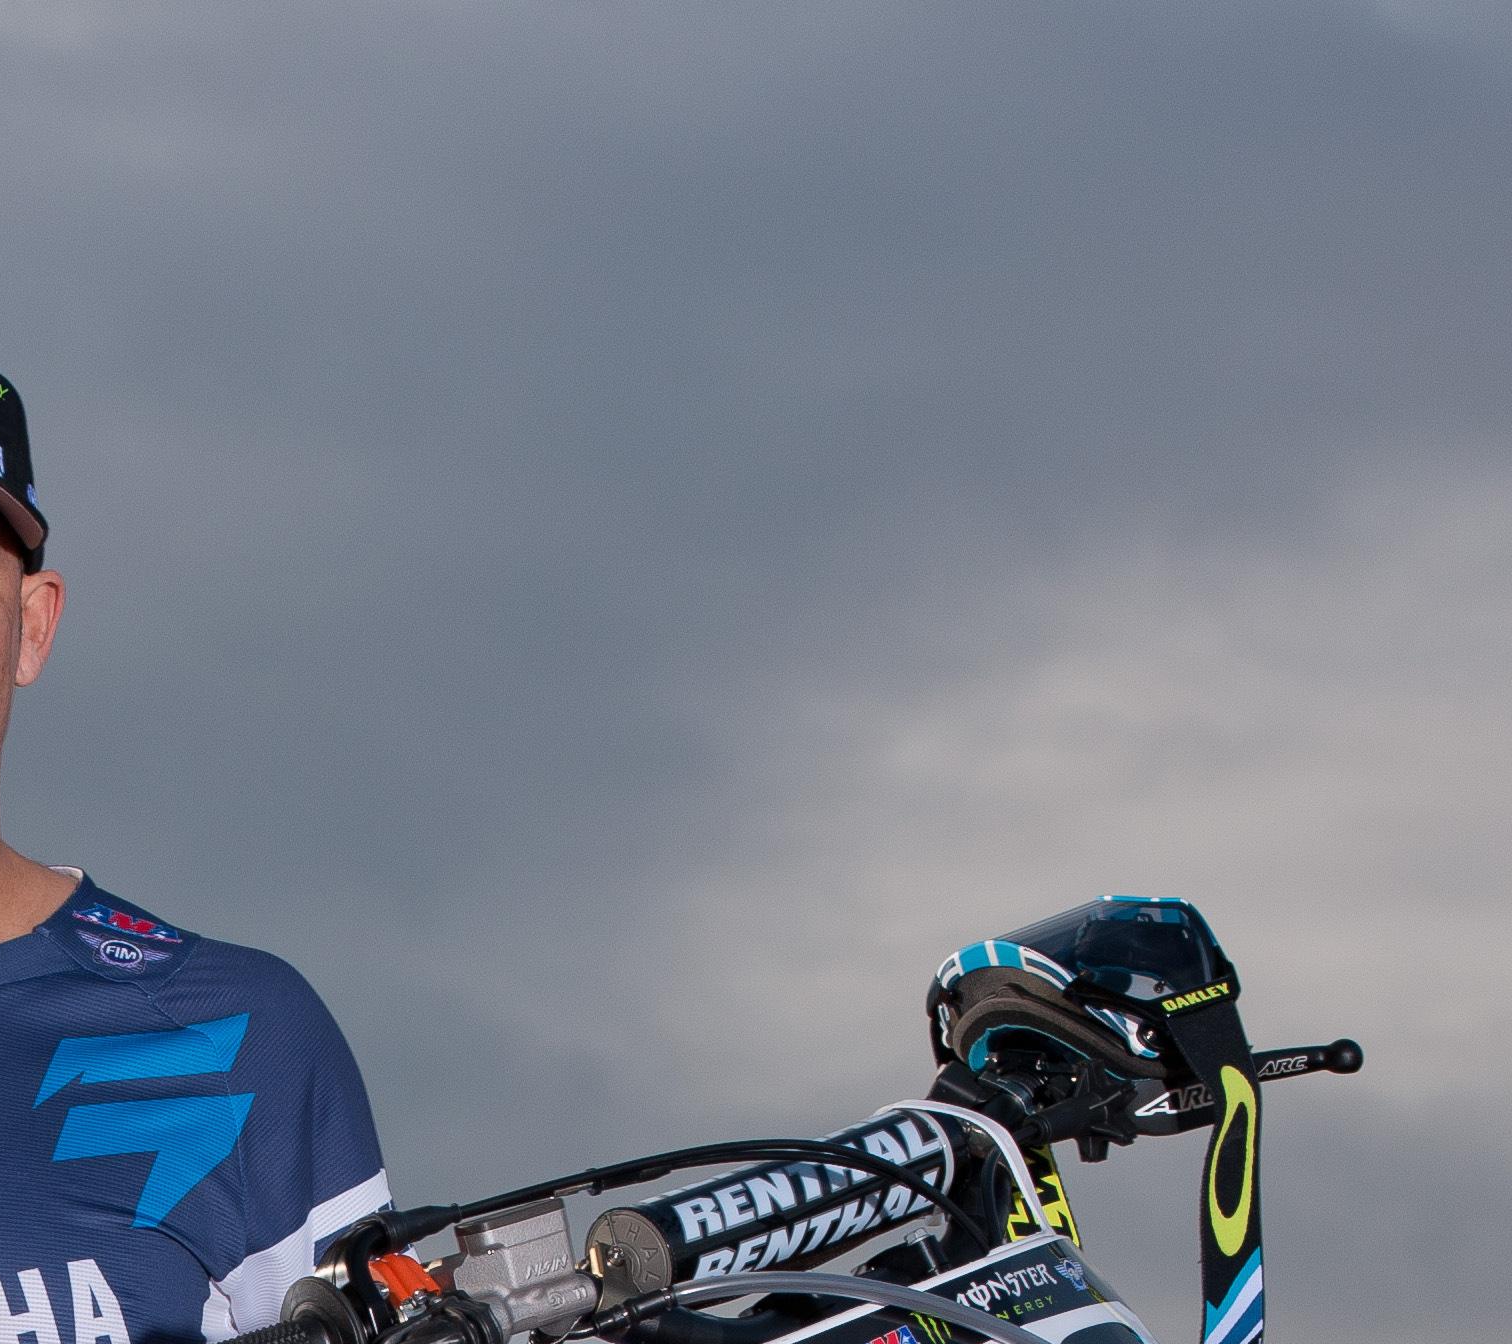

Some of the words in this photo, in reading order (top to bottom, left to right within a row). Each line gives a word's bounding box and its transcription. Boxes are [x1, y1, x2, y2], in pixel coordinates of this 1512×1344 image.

[105, 945, 137, 960] FIM
[1161, 981, 1231, 1012] OAKLEY
[1256, 1056, 1308, 1077] ARC
[673, 1117, 944, 1243] RENTHAL
[994, 1294, 1054, 1321] NERGY
